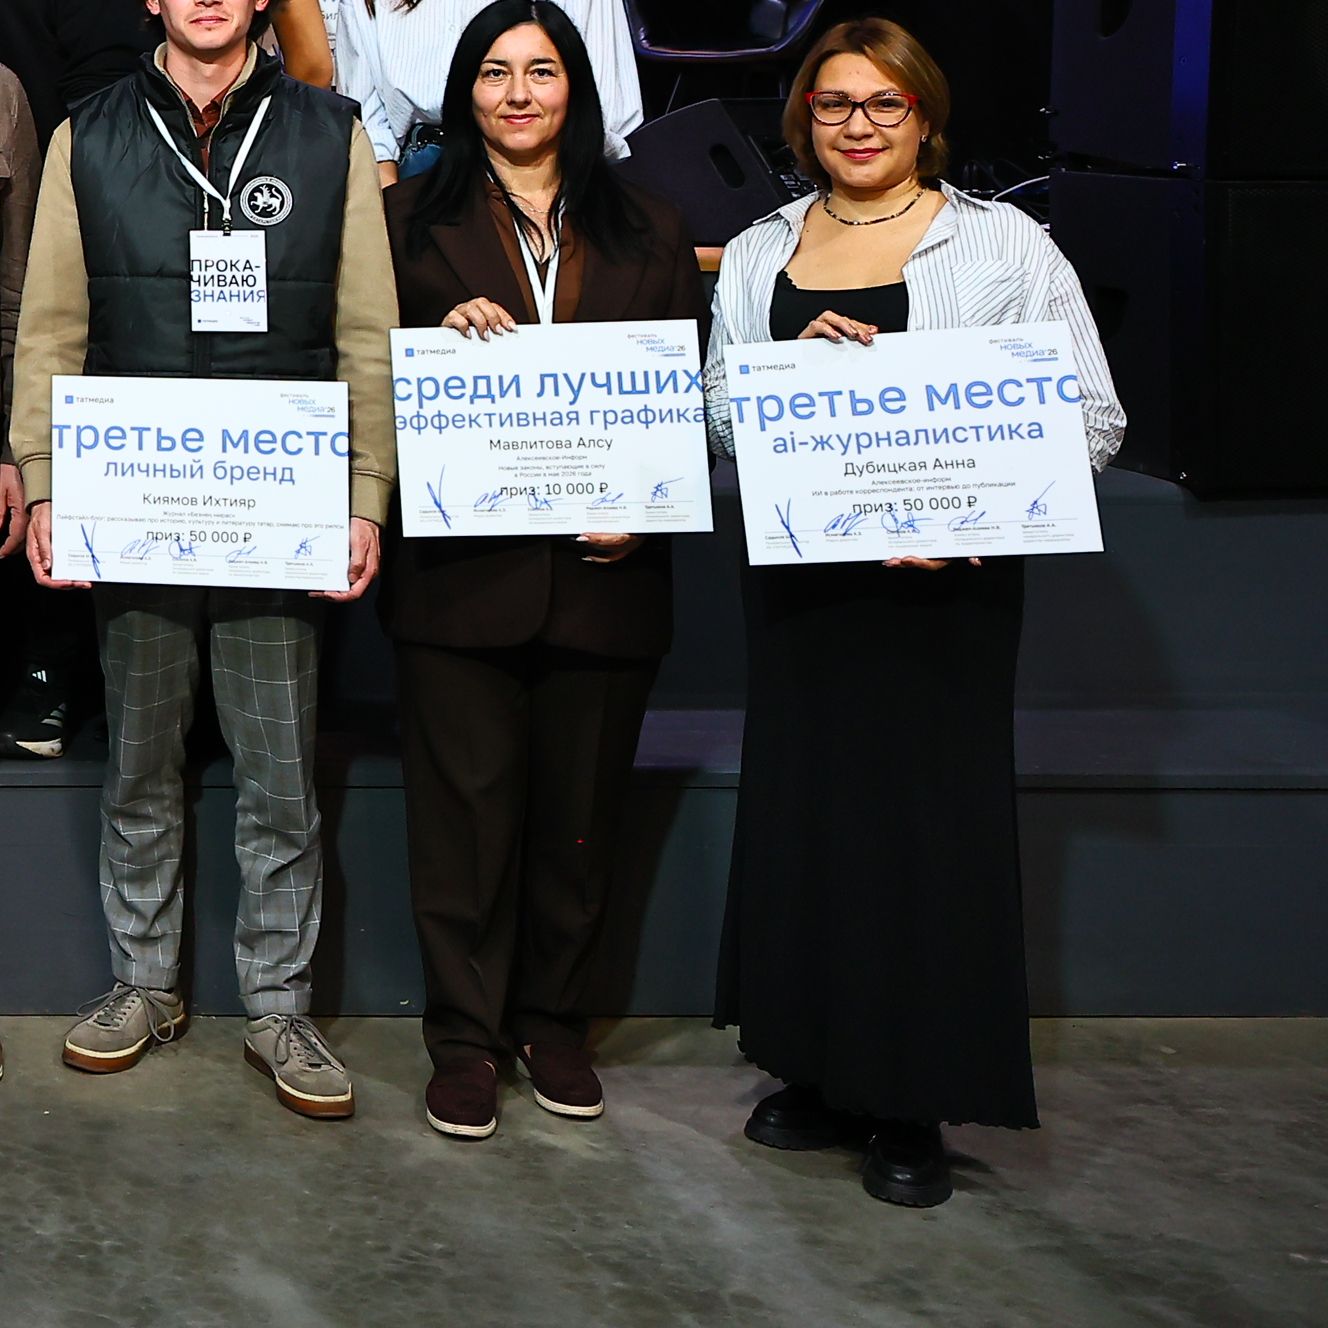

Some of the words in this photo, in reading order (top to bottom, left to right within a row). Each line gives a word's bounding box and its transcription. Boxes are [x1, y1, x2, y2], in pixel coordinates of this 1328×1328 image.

[191, 260, 260, 272] ПРОКА-
[191, 275, 256, 287] ЧИВАЮ
[191, 290, 265, 302] ЗНАНИЯ
[416, 348, 456, 356] татмедиа
[1000, 342, 1033, 350] новых
[752, 362, 796, 372] татмедиа
[394, 374, 522, 409] среди
[537, 368, 704, 406] лучших
[730, 386, 906, 431] третье
[928, 374, 1081, 412] место
[396, 409, 580, 435] эффективная
[590, 404, 706, 430] графика
[52, 424, 204, 458] третье
[222, 428, 350, 457] место
[489, 438, 572, 451] Мавлитова
[576, 436, 613, 451] Алсу
[772, 420, 1044, 456] ai-журналистика
[104, 459, 203, 479] личный
[213, 460, 296, 486] бренд
[843, 461, 928, 478] Дубицкая
[933, 457, 976, 470] Анна
[500, 484, 540, 498] приз:
[545, 484, 561, 495] 10
[566, 483, 595, 494] 000
[599, 482, 608, 493] ₽
[973, 481, 1015, 489] публикации
[142, 494, 198, 507] Киямов
[203, 495, 256, 509] Ихтияр
[852, 503, 897, 516] приз:
[903, 499, 923, 511] 50
[929, 497, 961, 510] 000
[967, 496, 977, 508] ₽
[147, 531, 185, 543] приз:
[190, 531, 206, 542] 50
[212, 531, 238, 543] 000
[243, 532, 252, 543] ₽
